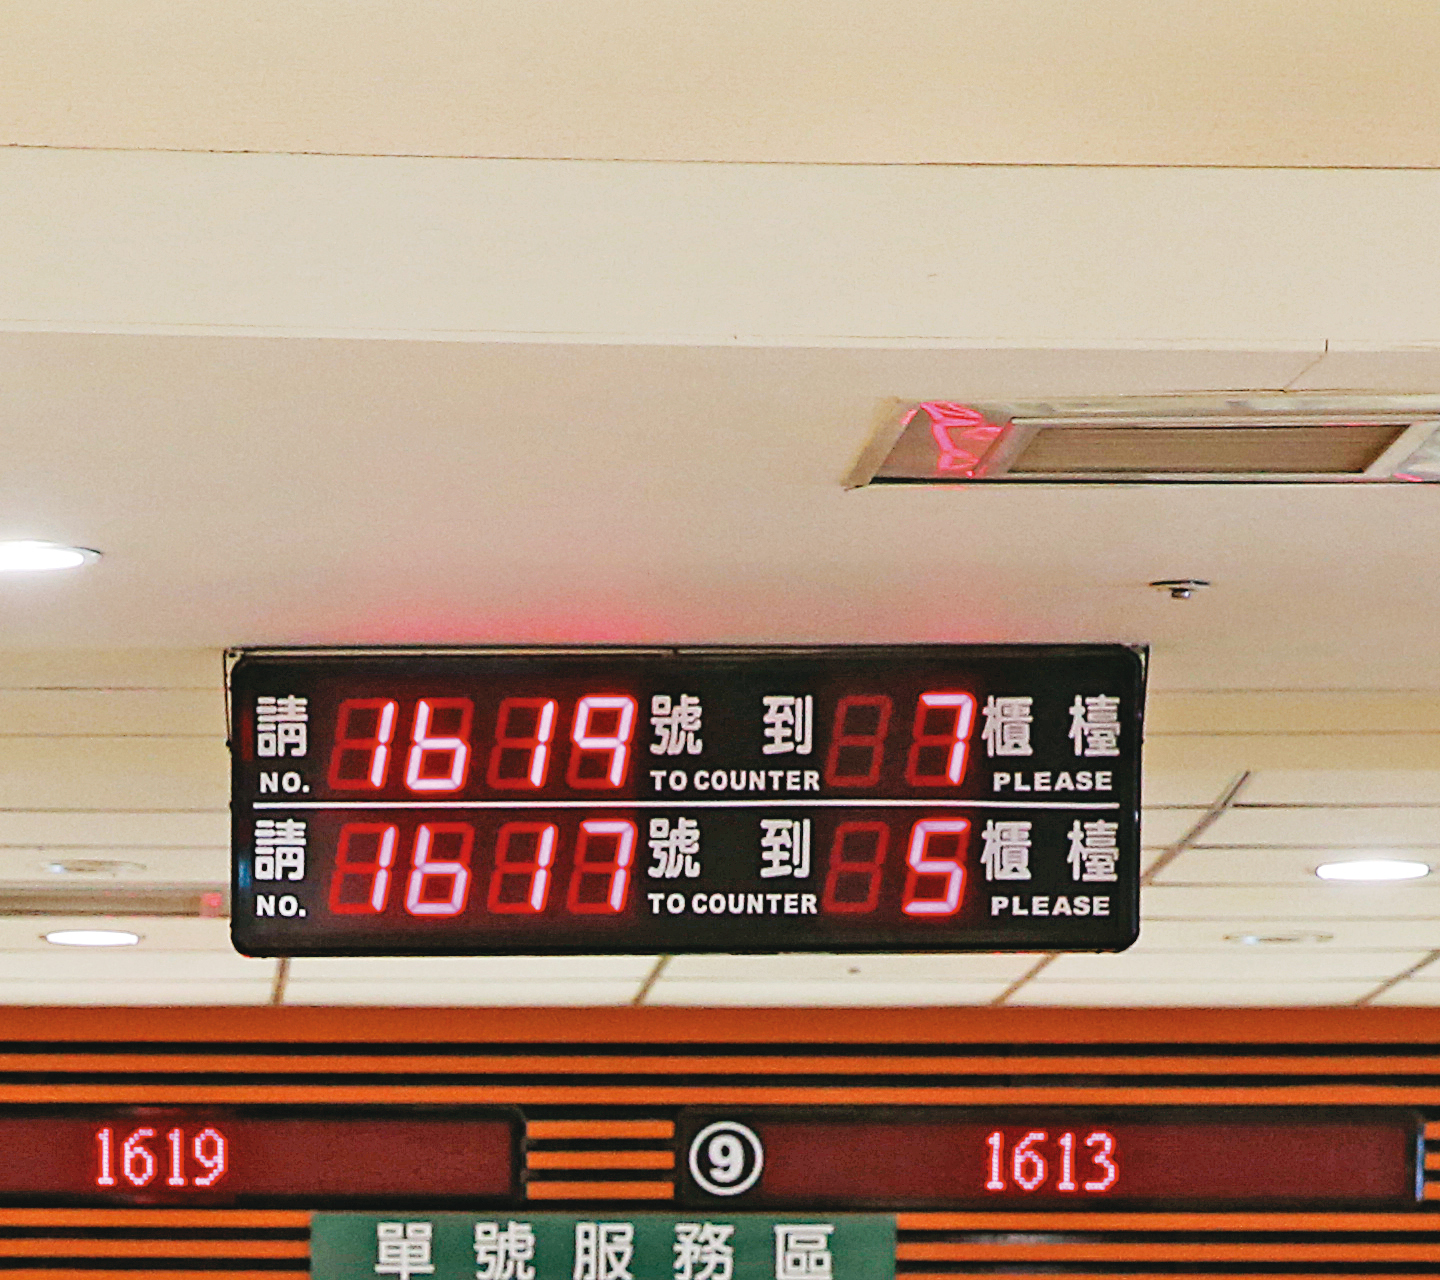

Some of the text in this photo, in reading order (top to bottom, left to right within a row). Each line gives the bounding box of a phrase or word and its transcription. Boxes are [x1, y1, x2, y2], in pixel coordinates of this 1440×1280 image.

[255, 695, 307, 758] 請
[369, 695, 639, 792] 1619
[920, 692, 978, 787] 7
[259, 770, 1112, 793] NO. TO COUNTER PLEASE
[254, 819, 307, 883] 請
[369, 821, 637, 916] 1617
[902, 819, 970, 916] 5
[255, 893, 1111, 919] NO. TO COUNTER PLEASE
[94, 1127, 227, 1188] 1619
[985, 1131, 1117, 1192] 1613
